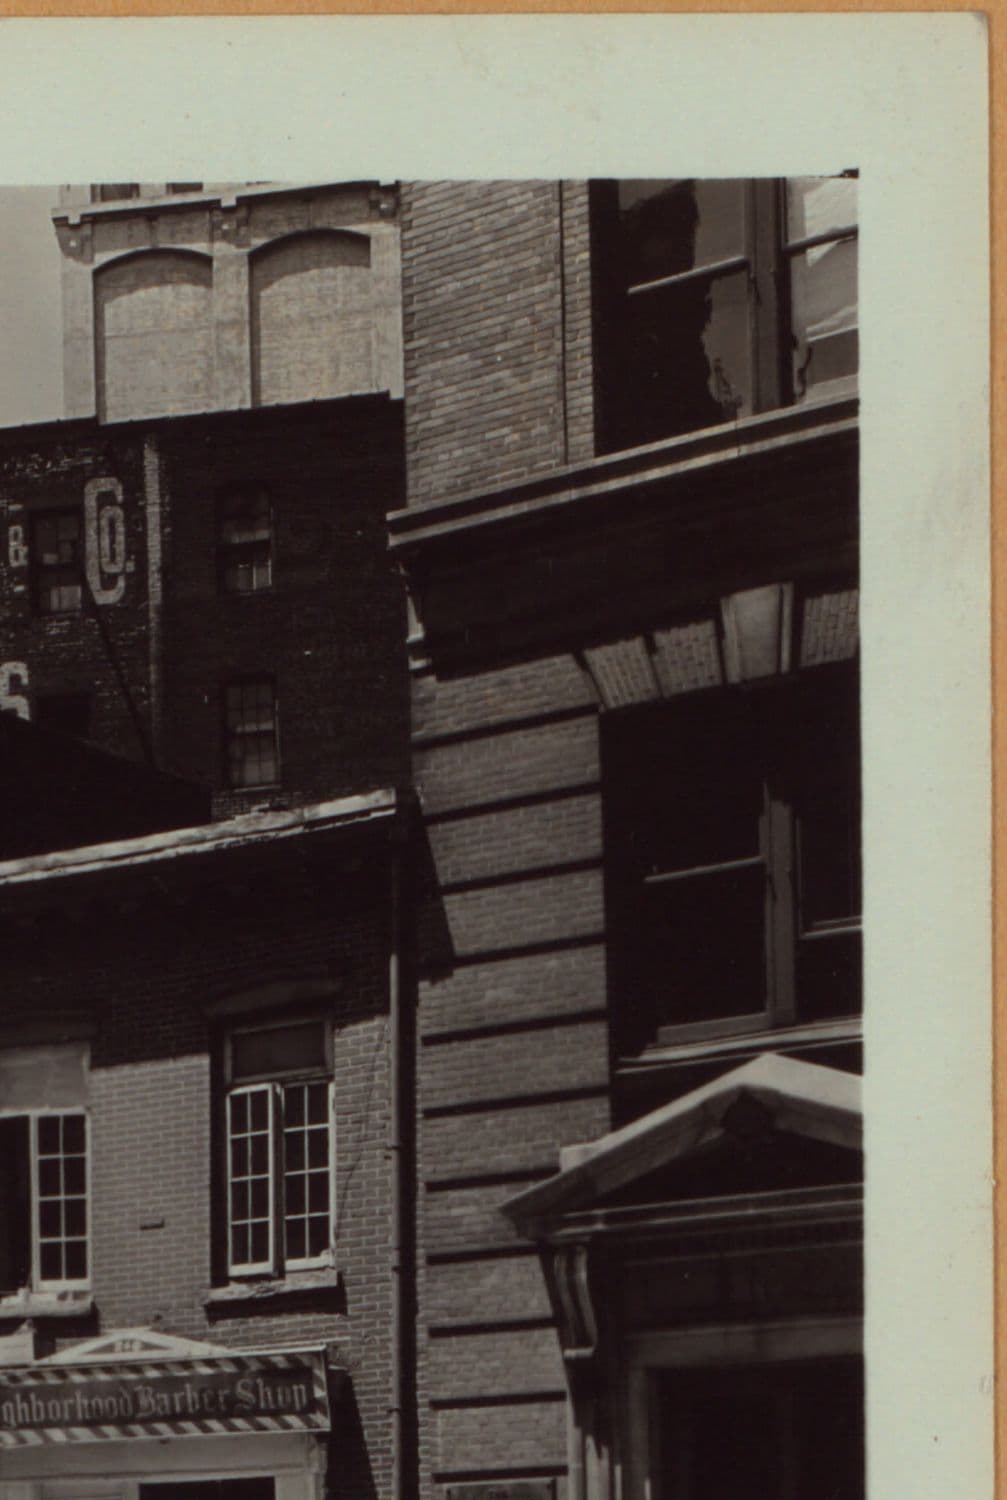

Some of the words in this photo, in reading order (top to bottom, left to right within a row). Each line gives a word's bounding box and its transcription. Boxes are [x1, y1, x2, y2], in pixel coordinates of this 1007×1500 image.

[8, 525, 28, 568] &
[135, 1384, 229, 1417] Barber
[235, 1377, 308, 1413] Shop
